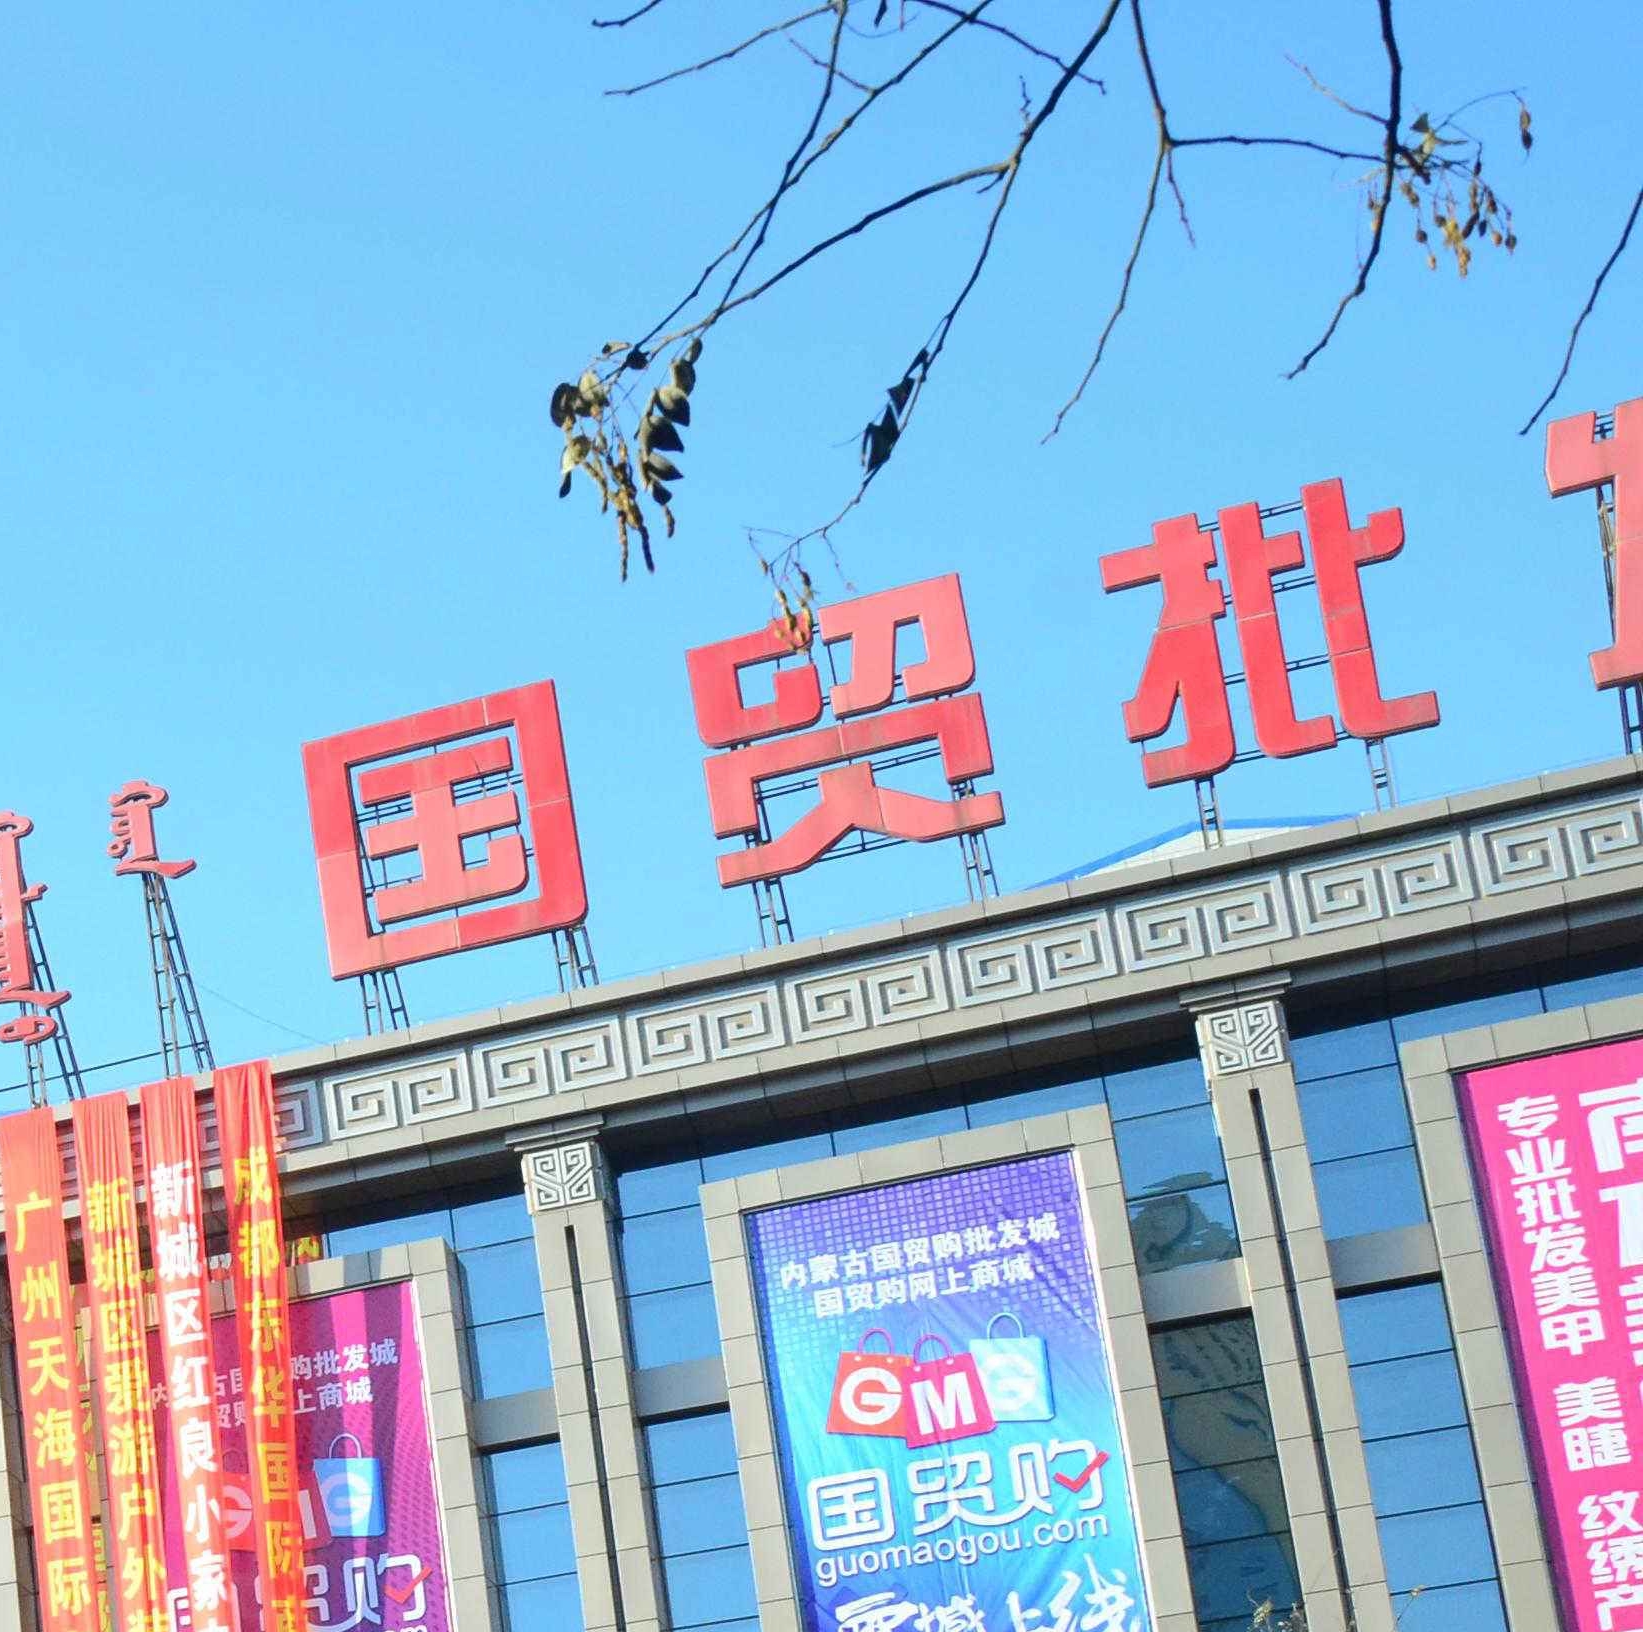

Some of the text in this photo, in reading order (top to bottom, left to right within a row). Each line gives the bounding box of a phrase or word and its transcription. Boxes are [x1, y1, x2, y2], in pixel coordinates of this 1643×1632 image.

[779, 1212, 1060, 1291] 内蒙古国贸购批发城
[1497, 1094, 1605, 1358] 专业批发美甲
[814, 1256, 1035, 1318] 国贸购网上商城
[806, 1438, 1111, 1551] 国贸购
[816, 1512, 1110, 1587] guomaogou.com
